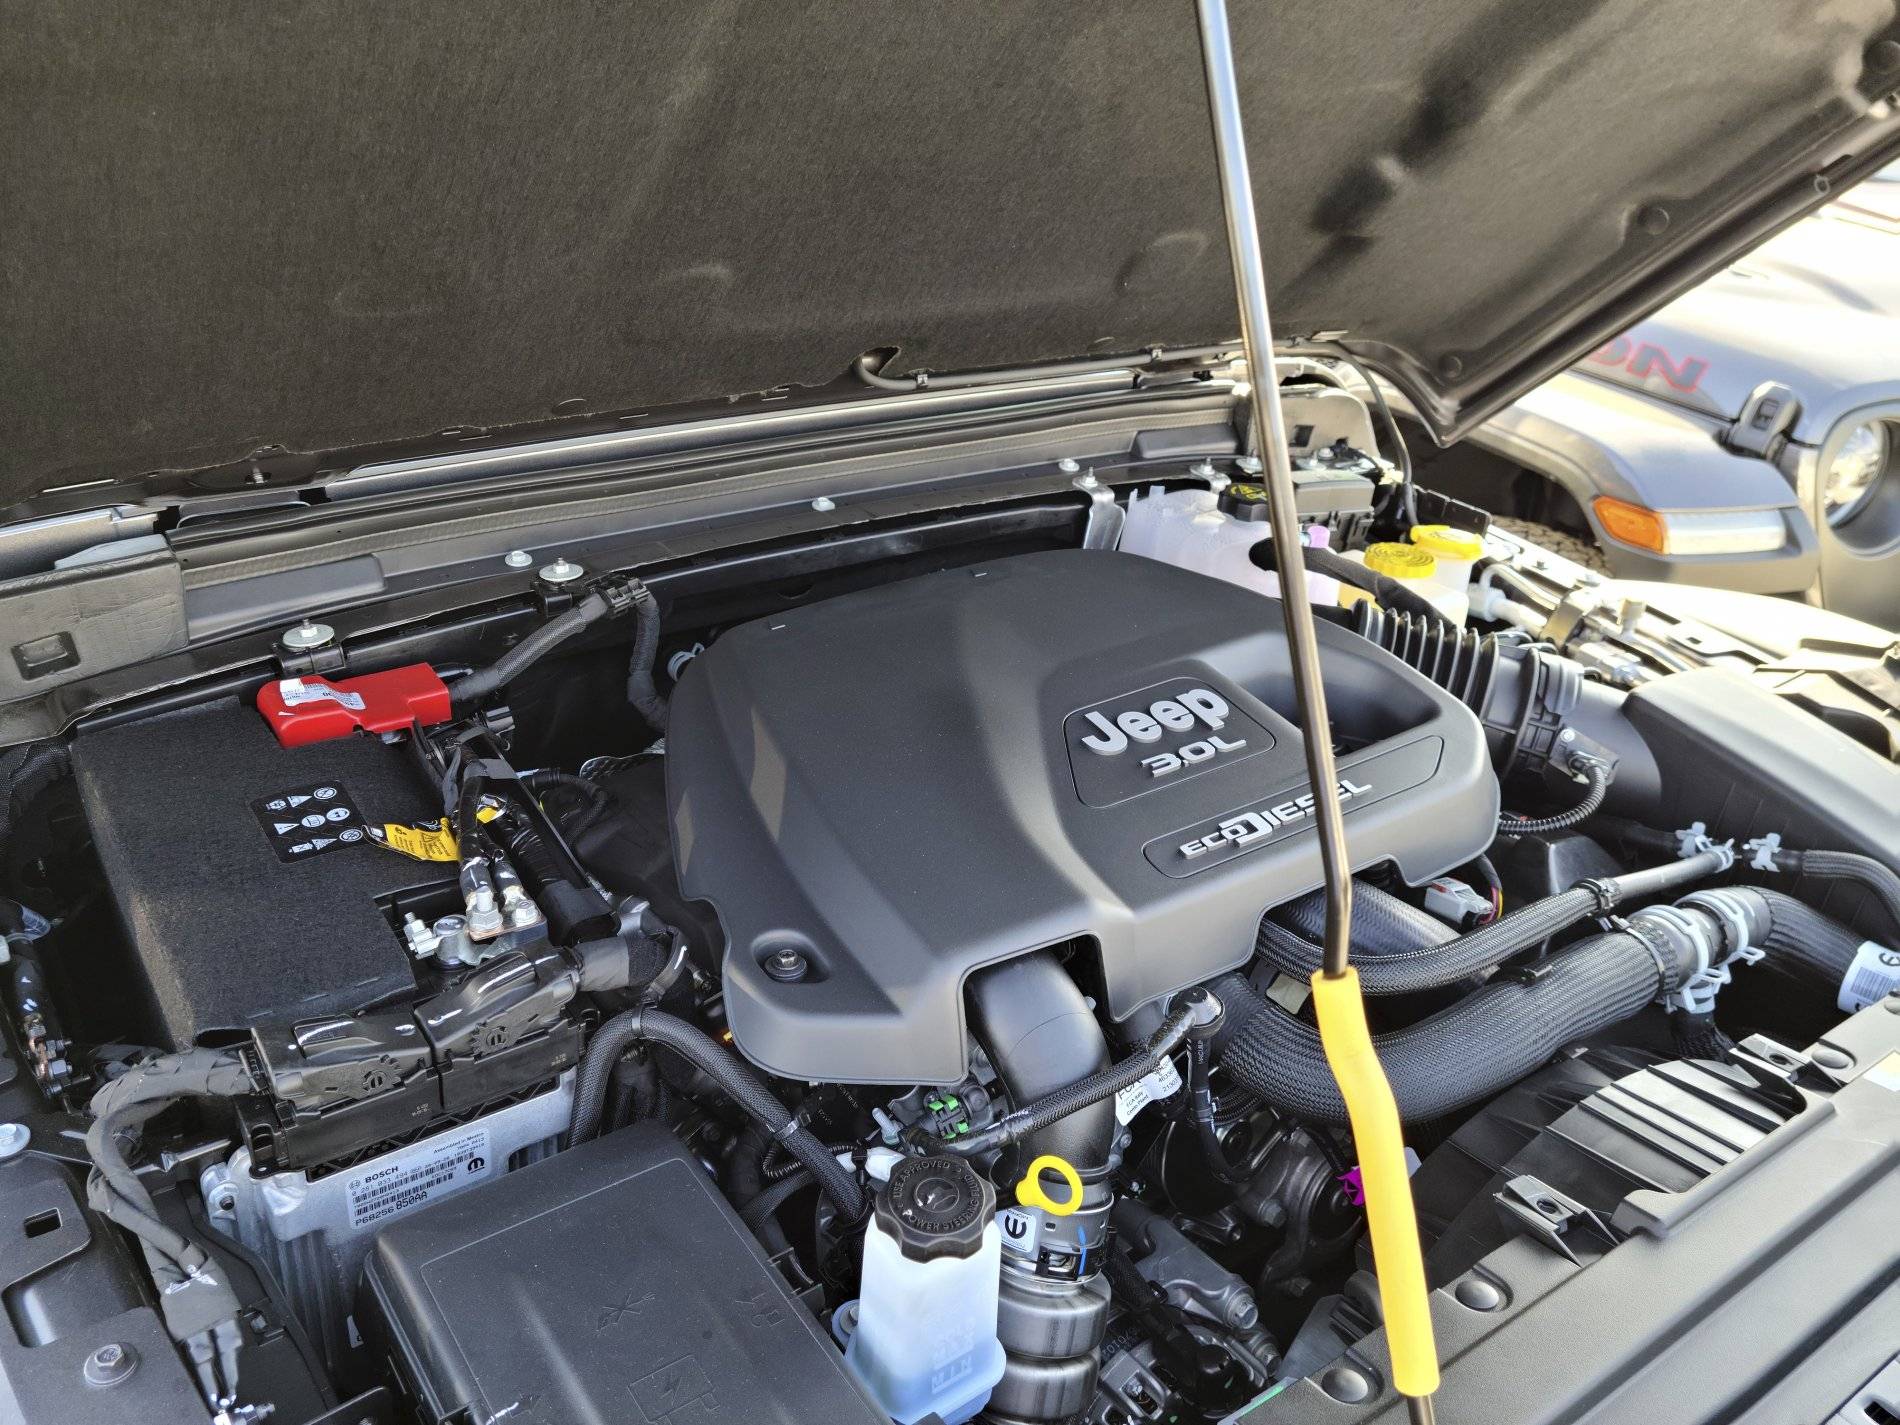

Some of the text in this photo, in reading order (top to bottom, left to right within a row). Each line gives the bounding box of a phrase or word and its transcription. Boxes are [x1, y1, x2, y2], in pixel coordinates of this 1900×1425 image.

[1081, 688, 1229, 756] Jeep
[1137, 735, 1247, 778] 3.0L
[365, 1166, 399, 1184] BOSCH
[893, 1160, 951, 1199] USE APPROVED
[396, 1191, 428, 1210] 850AA
[903, 1208, 940, 1231] POWER
[943, 1199, 979, 1230] STEERING
[964, 1173, 981, 1198] FLUID
